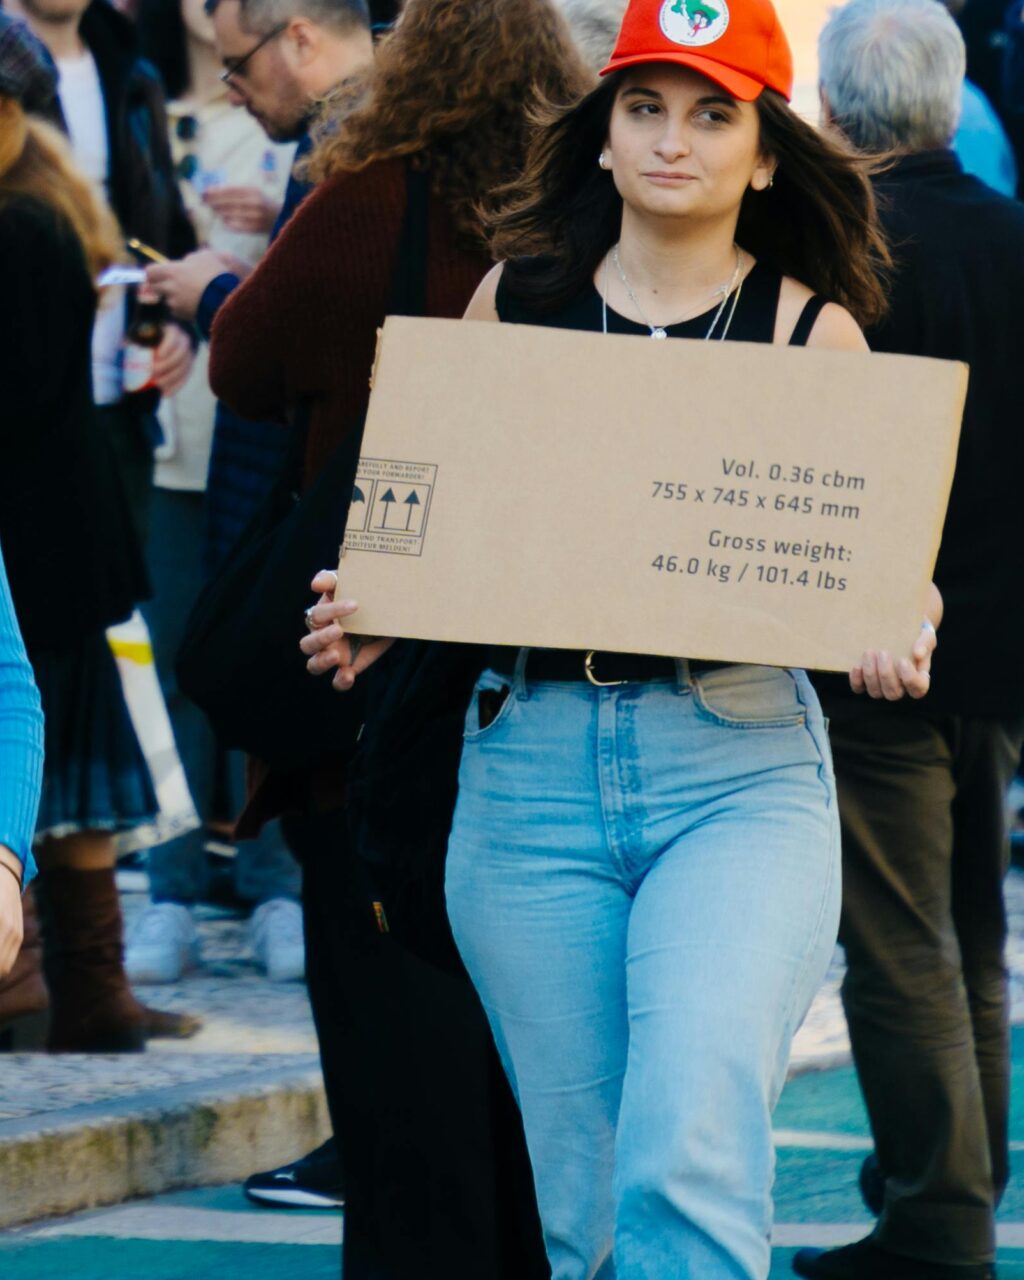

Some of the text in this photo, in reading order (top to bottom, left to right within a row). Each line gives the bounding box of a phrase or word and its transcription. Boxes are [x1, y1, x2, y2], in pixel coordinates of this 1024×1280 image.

[721, 458, 865, 490] Vol. 0.36 cbm
[651, 481, 860, 519] 755 x 745 x 645 mm
[708, 529, 852, 563] Gross weight:
[651, 554, 847, 591] 46.0 kg / 101.4 lbs
